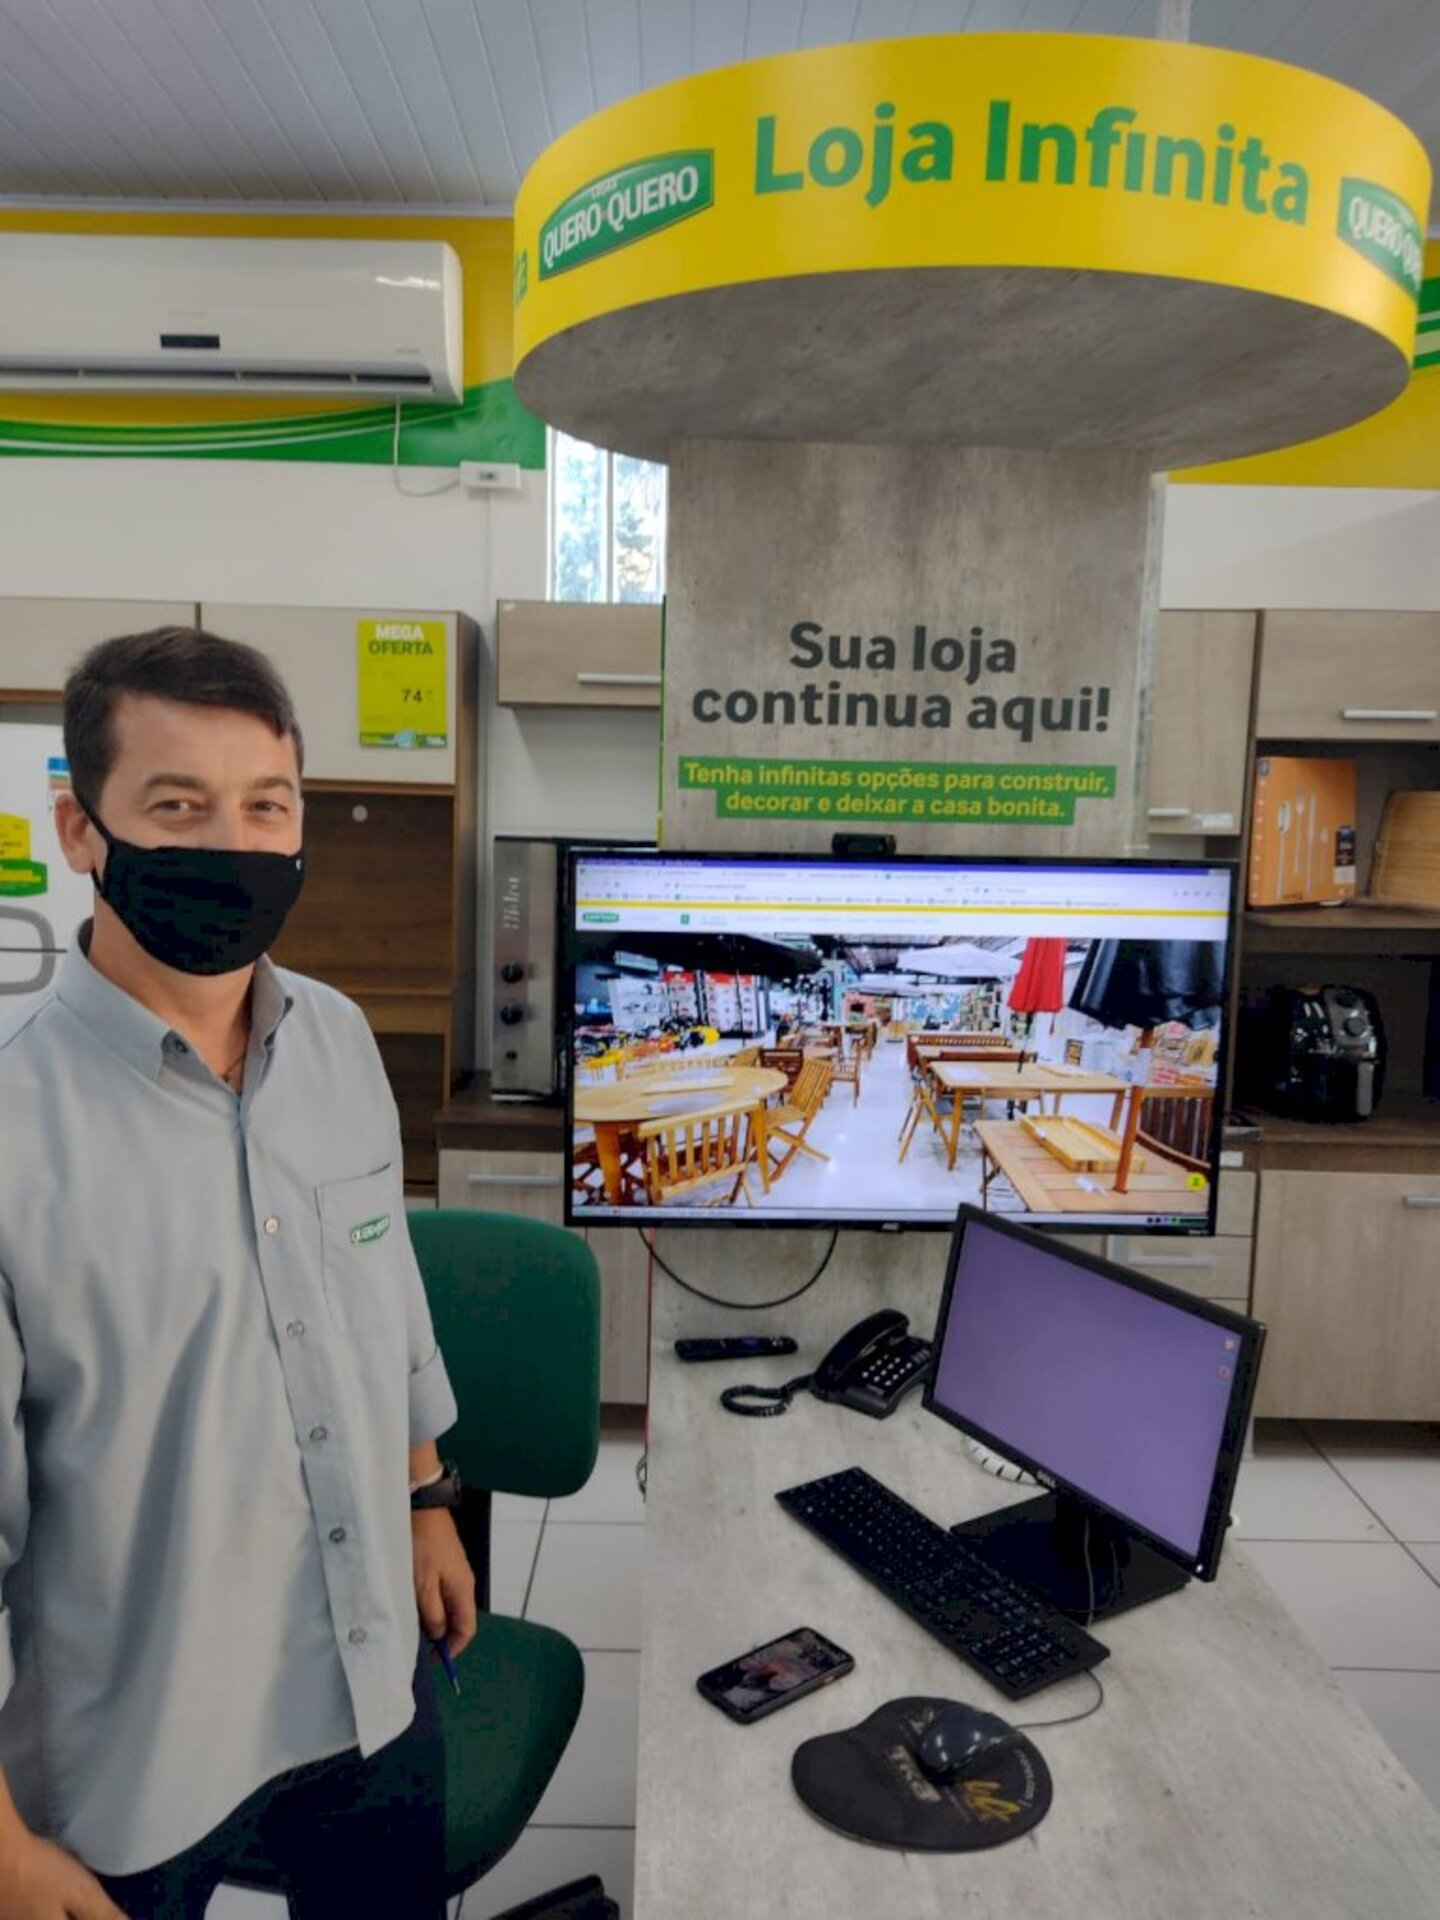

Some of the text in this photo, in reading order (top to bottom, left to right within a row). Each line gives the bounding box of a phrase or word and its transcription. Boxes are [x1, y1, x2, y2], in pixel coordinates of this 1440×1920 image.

[755, 100, 1309, 226] Loja Infinita
[375, 624, 424, 640] MEGA
[368, 641, 434, 656] OFERTA
[789, 621, 1017, 685] Sua loja
[692, 681, 1111, 742] continua aqui!
[685, 762, 1109, 794] Tenha infinitas opções para construir,
[726, 791, 1065, 817] decorar e deixar a casa bonita.
